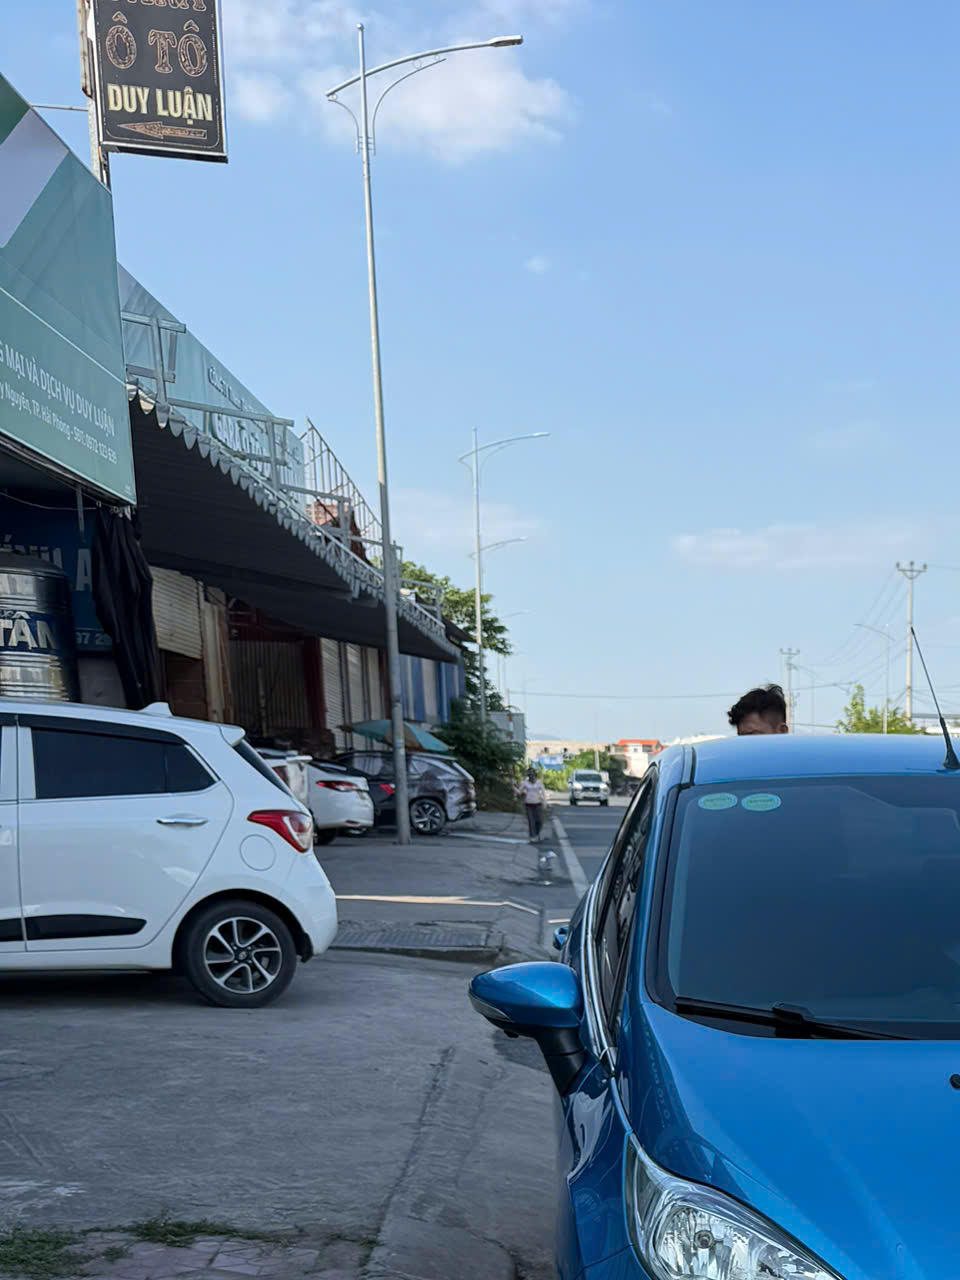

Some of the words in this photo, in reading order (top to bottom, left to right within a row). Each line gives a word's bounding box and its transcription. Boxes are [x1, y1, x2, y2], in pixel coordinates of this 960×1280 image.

[105, 10, 137, 70] Ô
[148, 19, 208, 77] TÔ
[107, 83, 150, 114] DUY
[155, 85, 213, 125] LUẬN
[5, 343, 26, 380] MẠI
[26, 356, 40, 387] VÀ
[40, 367, 62, 402] DỊCH
[62, 383, 75, 414] VỤ
[76, 393, 94, 423] DUY
[94, 406, 115, 437] LUẬN
